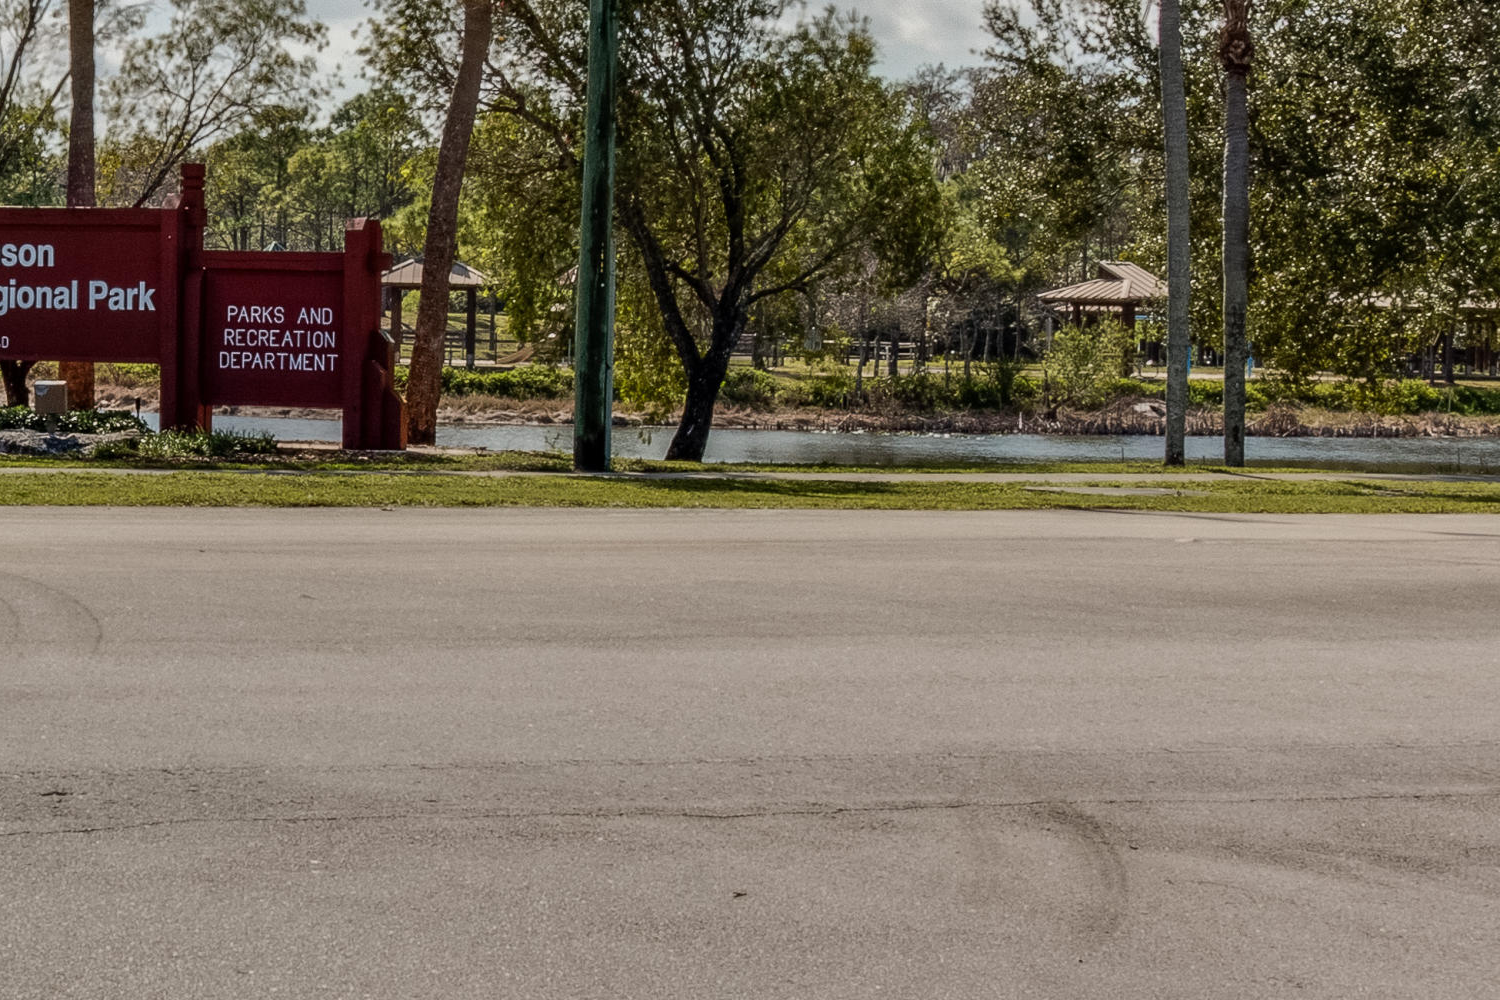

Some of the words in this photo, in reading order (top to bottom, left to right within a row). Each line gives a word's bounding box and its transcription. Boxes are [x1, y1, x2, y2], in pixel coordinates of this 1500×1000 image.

[88, 280, 156, 311] Park
[227, 305, 285, 324] PARKS
[297, 307, 333, 325] AND
[223, 328, 336, 349] RECREATION
[219, 351, 339, 372] DEPARTMENT
